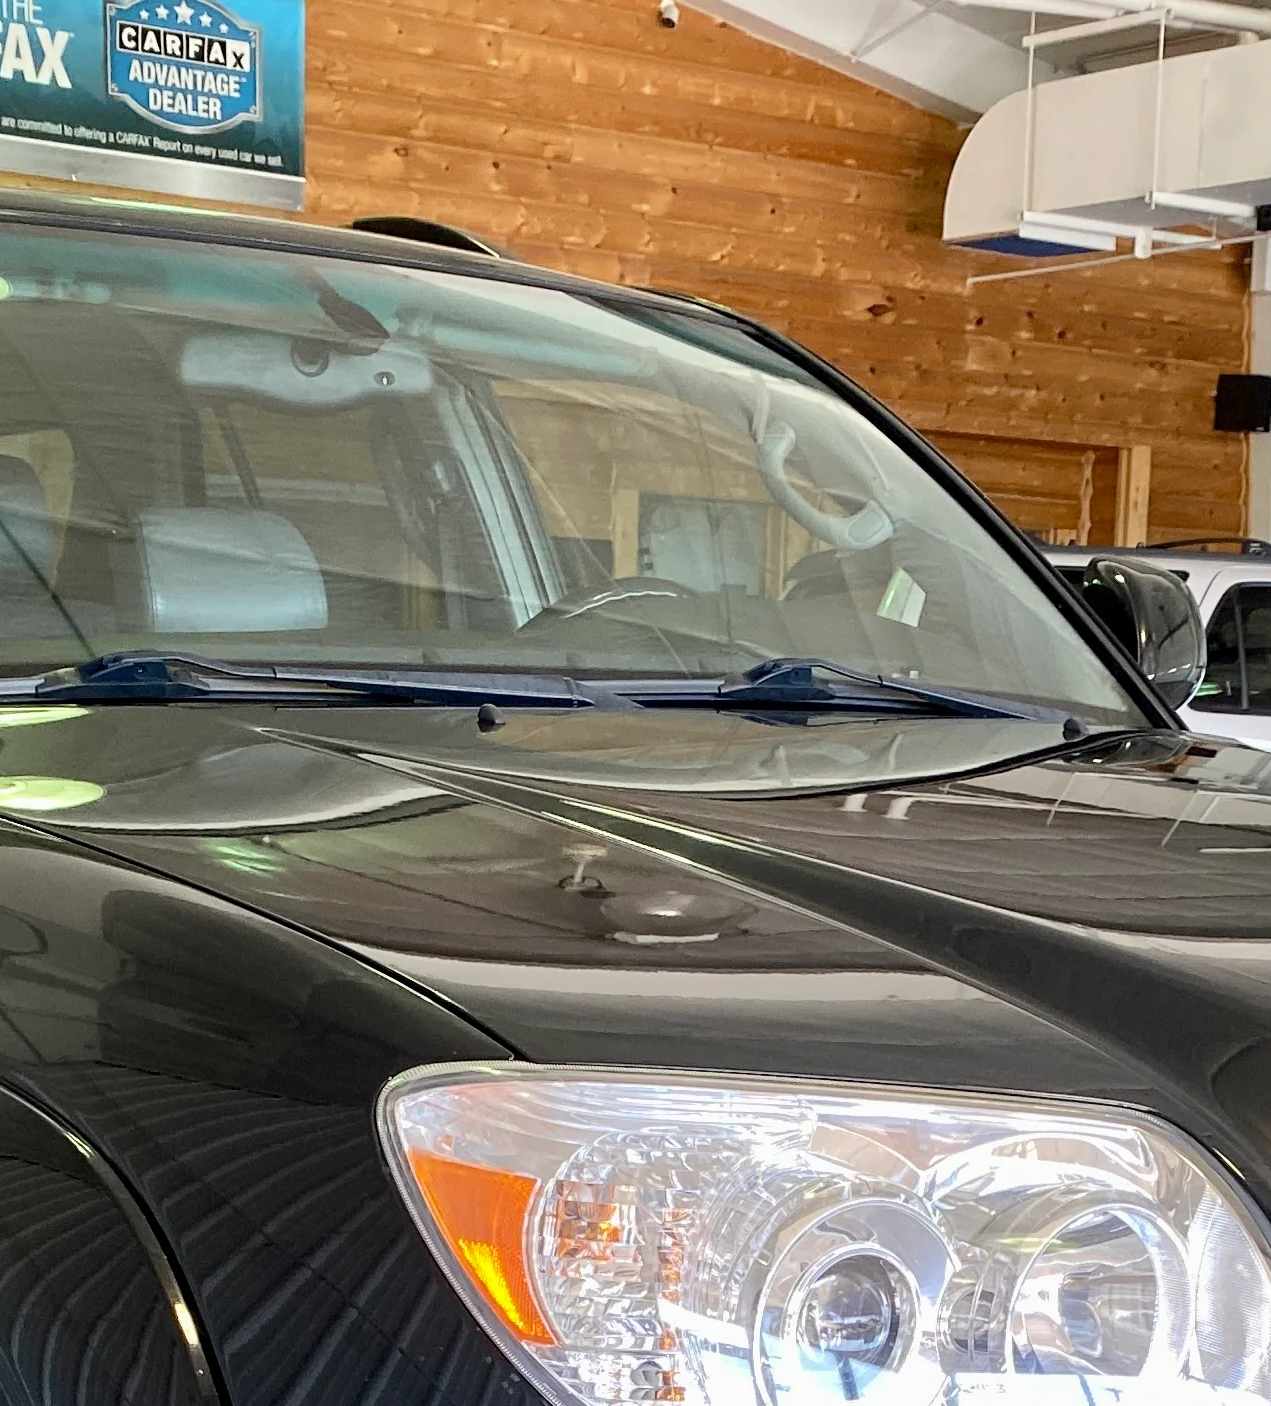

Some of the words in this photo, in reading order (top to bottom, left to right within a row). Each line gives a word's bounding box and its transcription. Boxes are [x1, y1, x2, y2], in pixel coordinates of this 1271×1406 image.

[120, 24, 246, 70] CARFAX
[129, 58, 241, 98] ADVANTAGE
[148, 87, 222, 121] DEALER
[116, 131, 153, 149] CARFAX
[154, 136, 182, 153] Report
[182, 142, 193, 154] on
